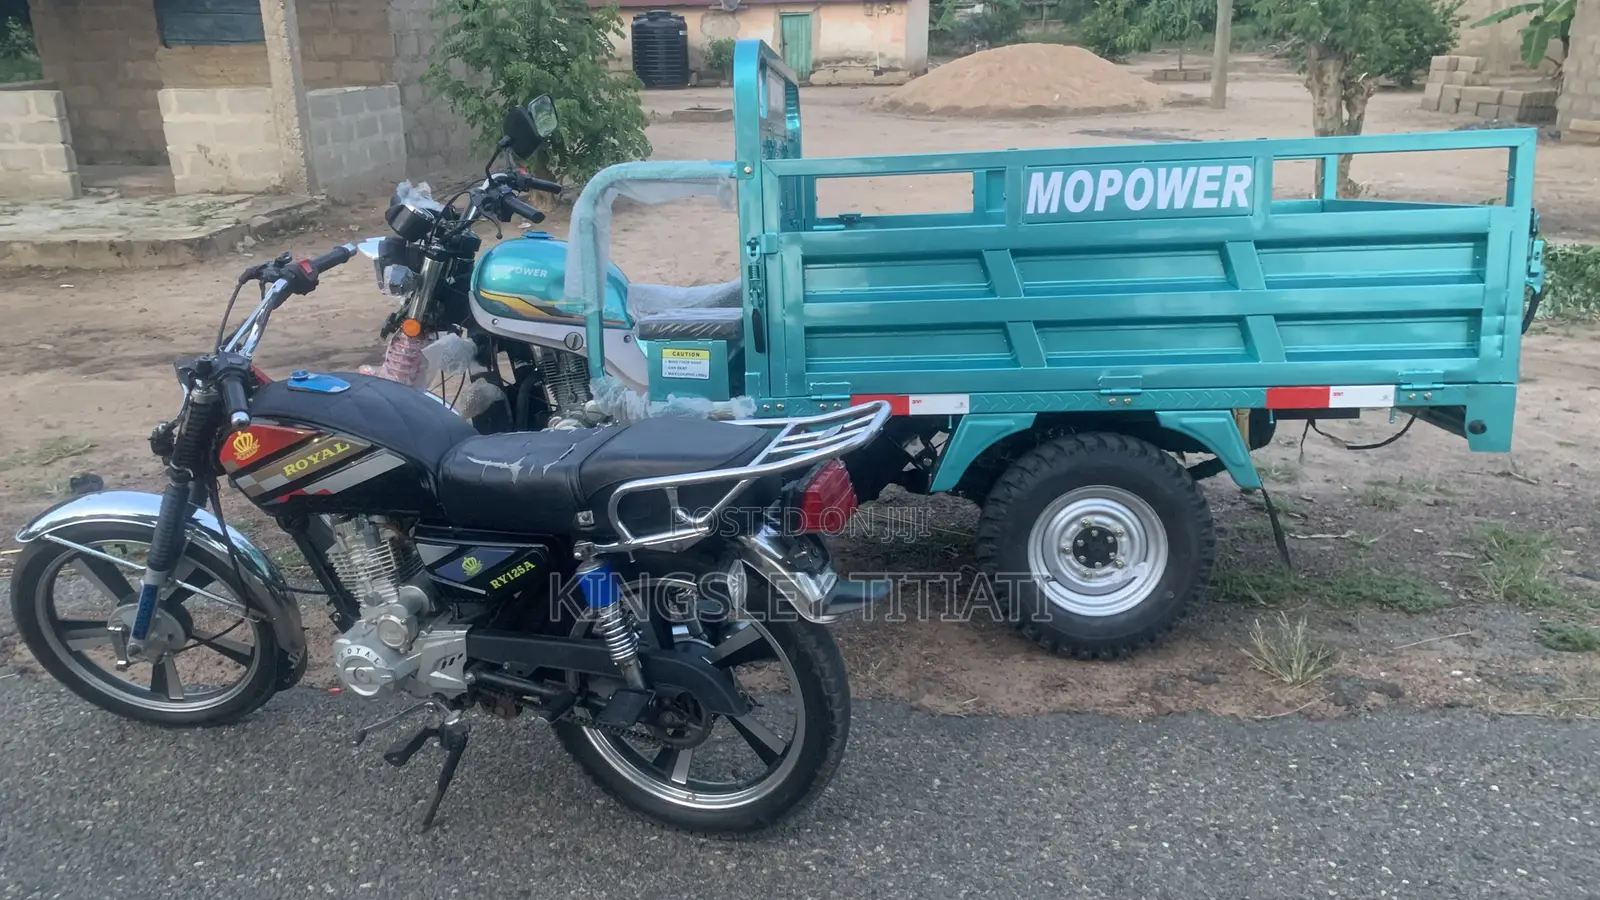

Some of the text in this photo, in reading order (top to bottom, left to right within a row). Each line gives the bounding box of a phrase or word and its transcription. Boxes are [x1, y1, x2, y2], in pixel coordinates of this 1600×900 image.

[1025, 165, 1252, 214] MOPOWER
[282, 442, 350, 477] ROYAL
[490, 561, 536, 589] RY125A
